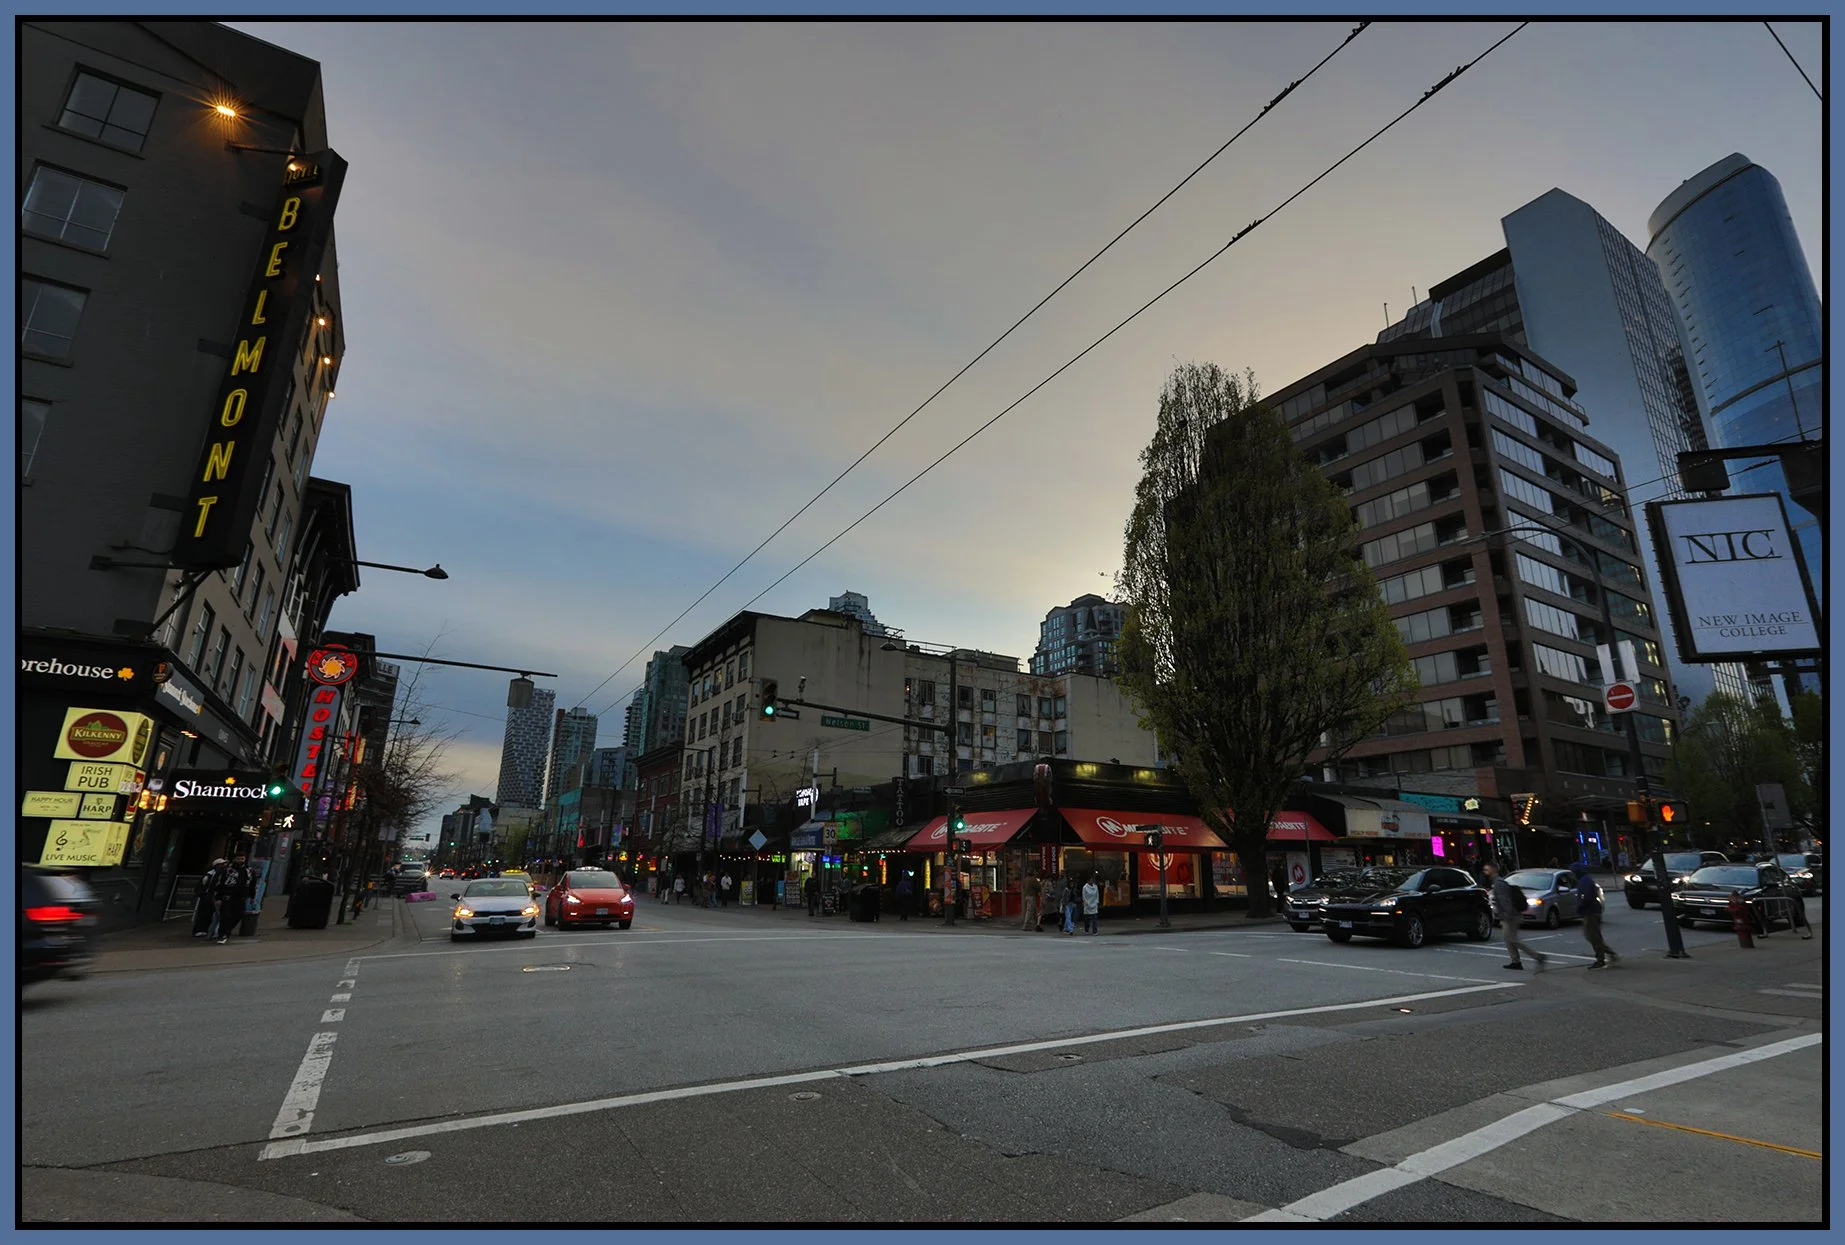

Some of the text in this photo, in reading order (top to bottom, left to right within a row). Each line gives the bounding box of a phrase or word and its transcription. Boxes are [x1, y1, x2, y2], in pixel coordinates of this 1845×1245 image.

[194, 196, 301, 538] BELMONT
[1679, 529, 1783, 564] NIC
[1698, 611, 1803, 627] NEW IMAGE
[1719, 625, 1788, 638] COLLEGE
[825, 717, 854, 728] Nelson
[73, 728, 122, 740] KILKENNY
[81, 765, 113, 776] IRISH
[77, 776, 110, 788] PUB
[173, 780, 268, 799] Shamrock
[895, 778, 905, 826] TATTOO
[82, 804, 111, 813] HARP
[825, 829, 835, 838] 30
[45, 853, 96, 862] LIVE MUSIC
